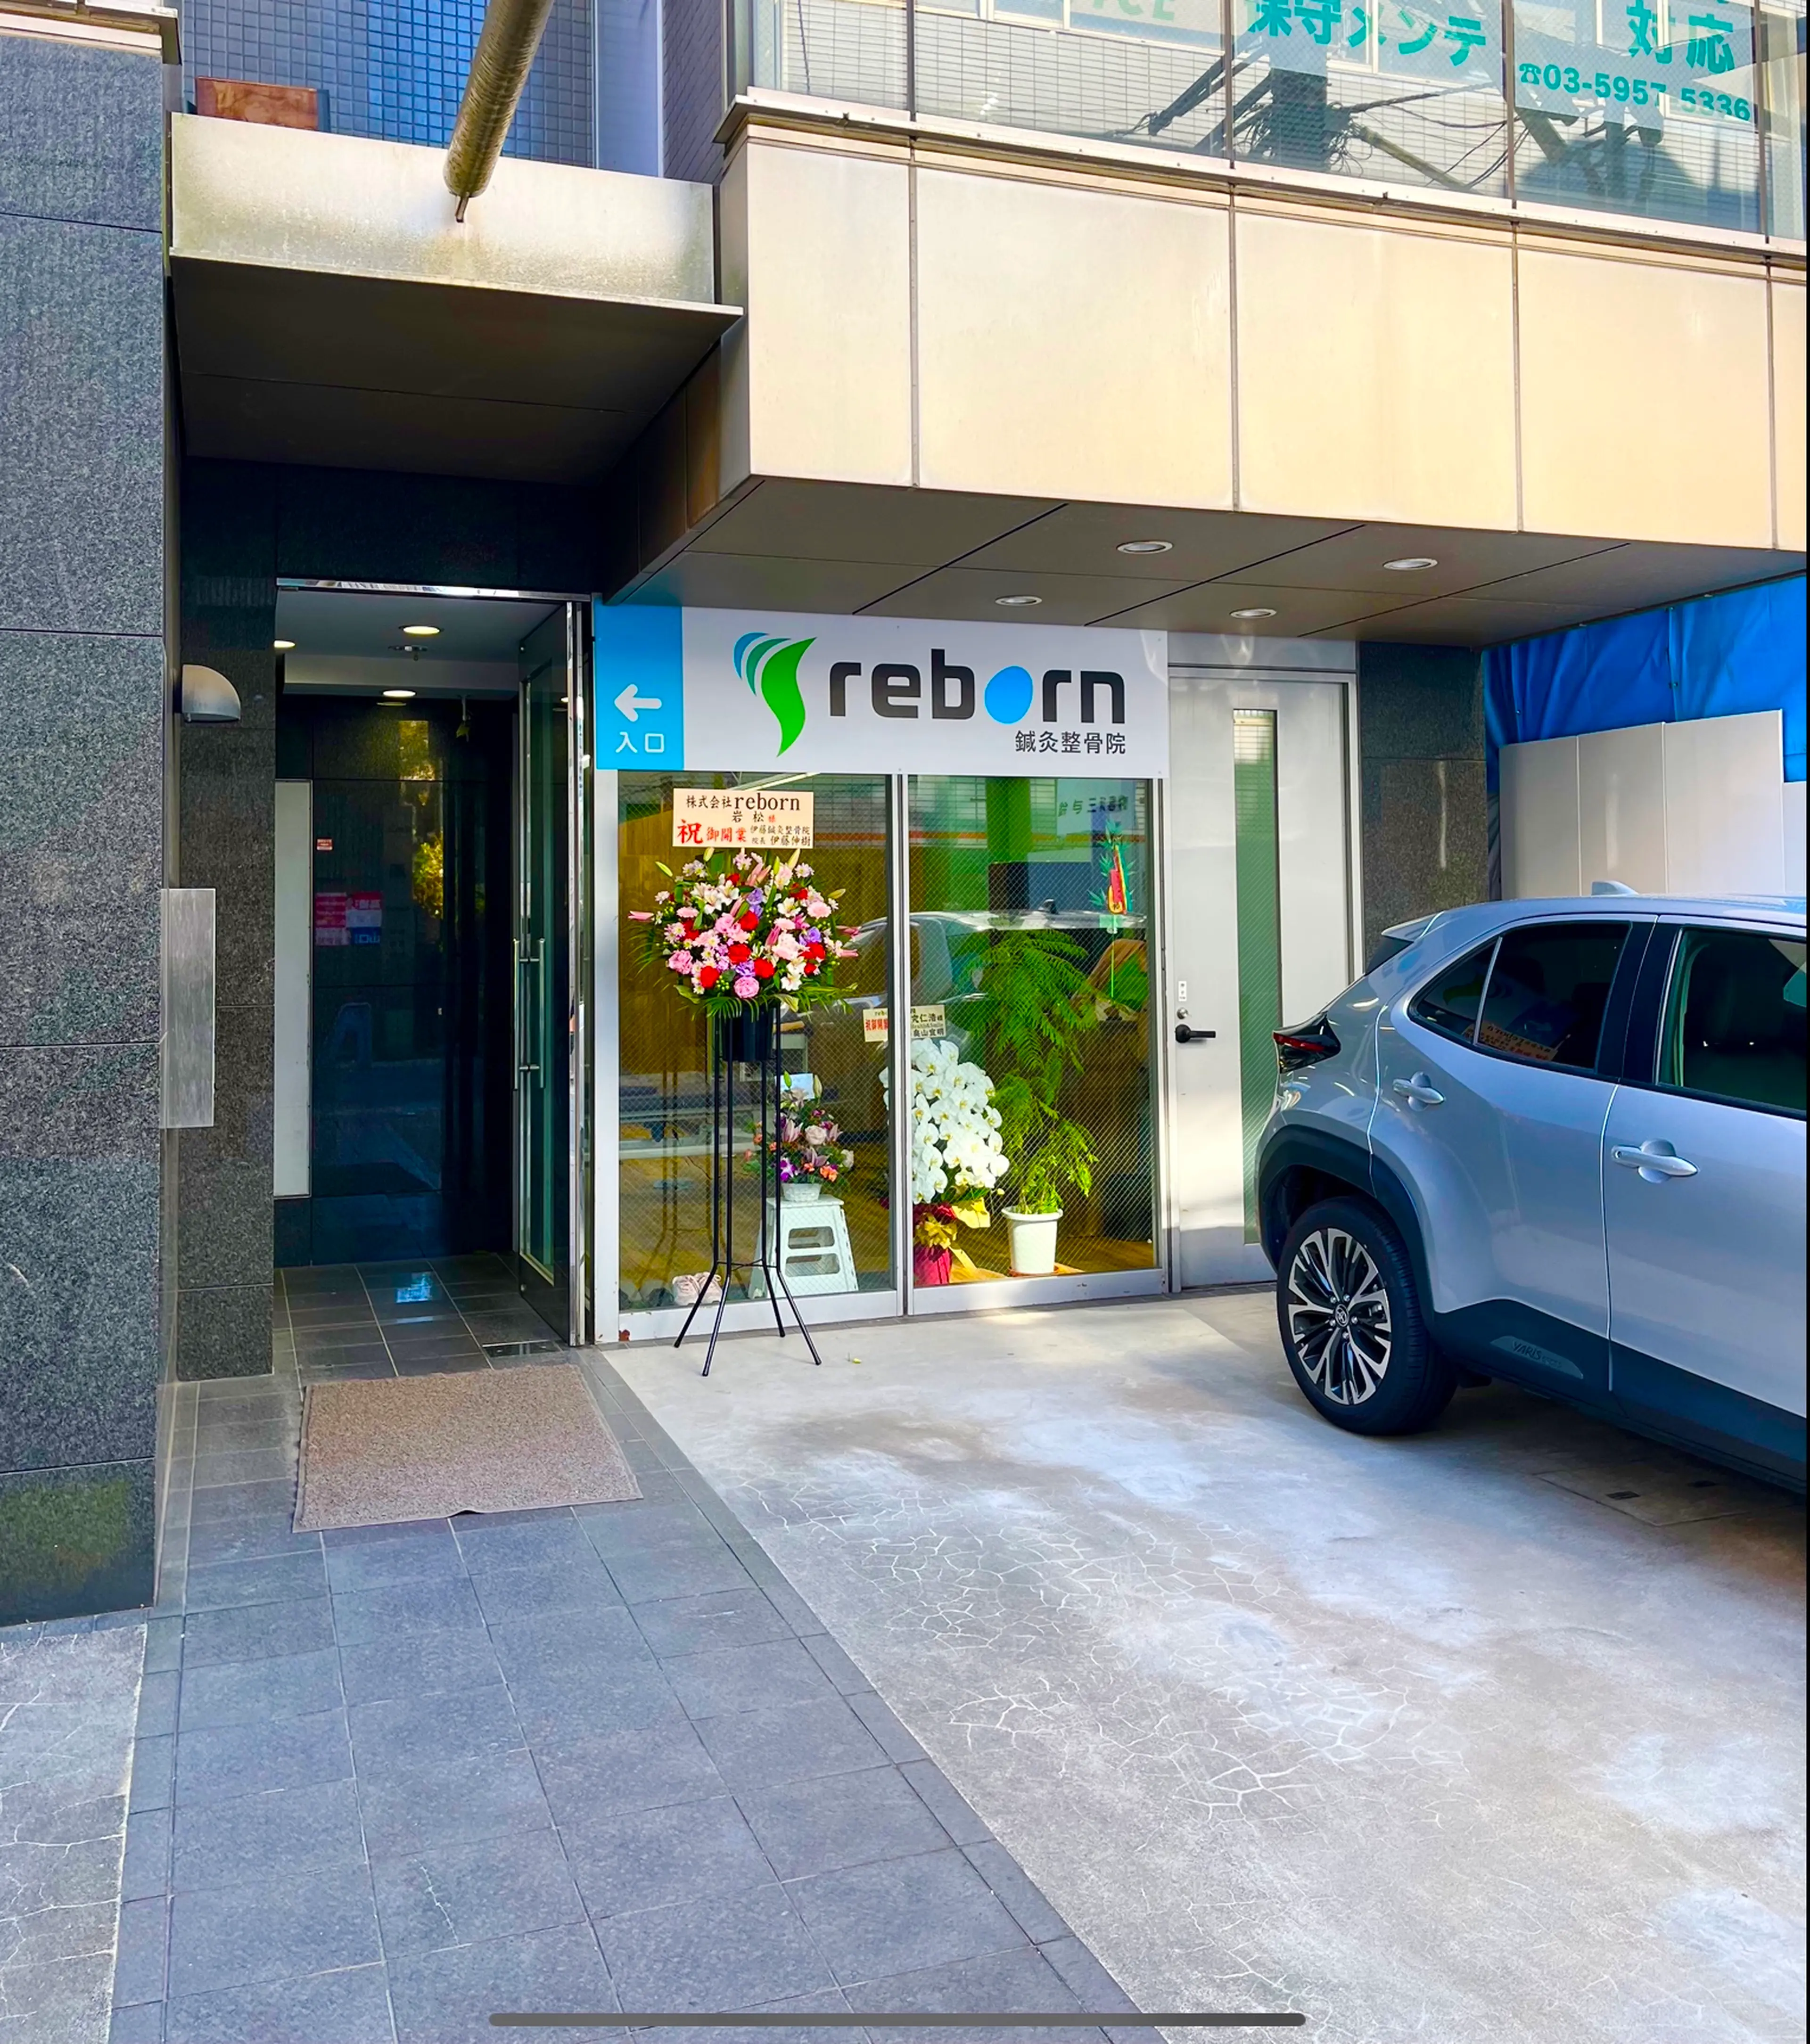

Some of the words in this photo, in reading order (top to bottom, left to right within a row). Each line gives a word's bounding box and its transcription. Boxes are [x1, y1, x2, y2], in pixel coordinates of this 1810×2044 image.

[830, 648, 1125, 724] reborn
[616, 731, 664, 753] 入口
[1015, 730, 1126, 755] 鍼灸整骨院
